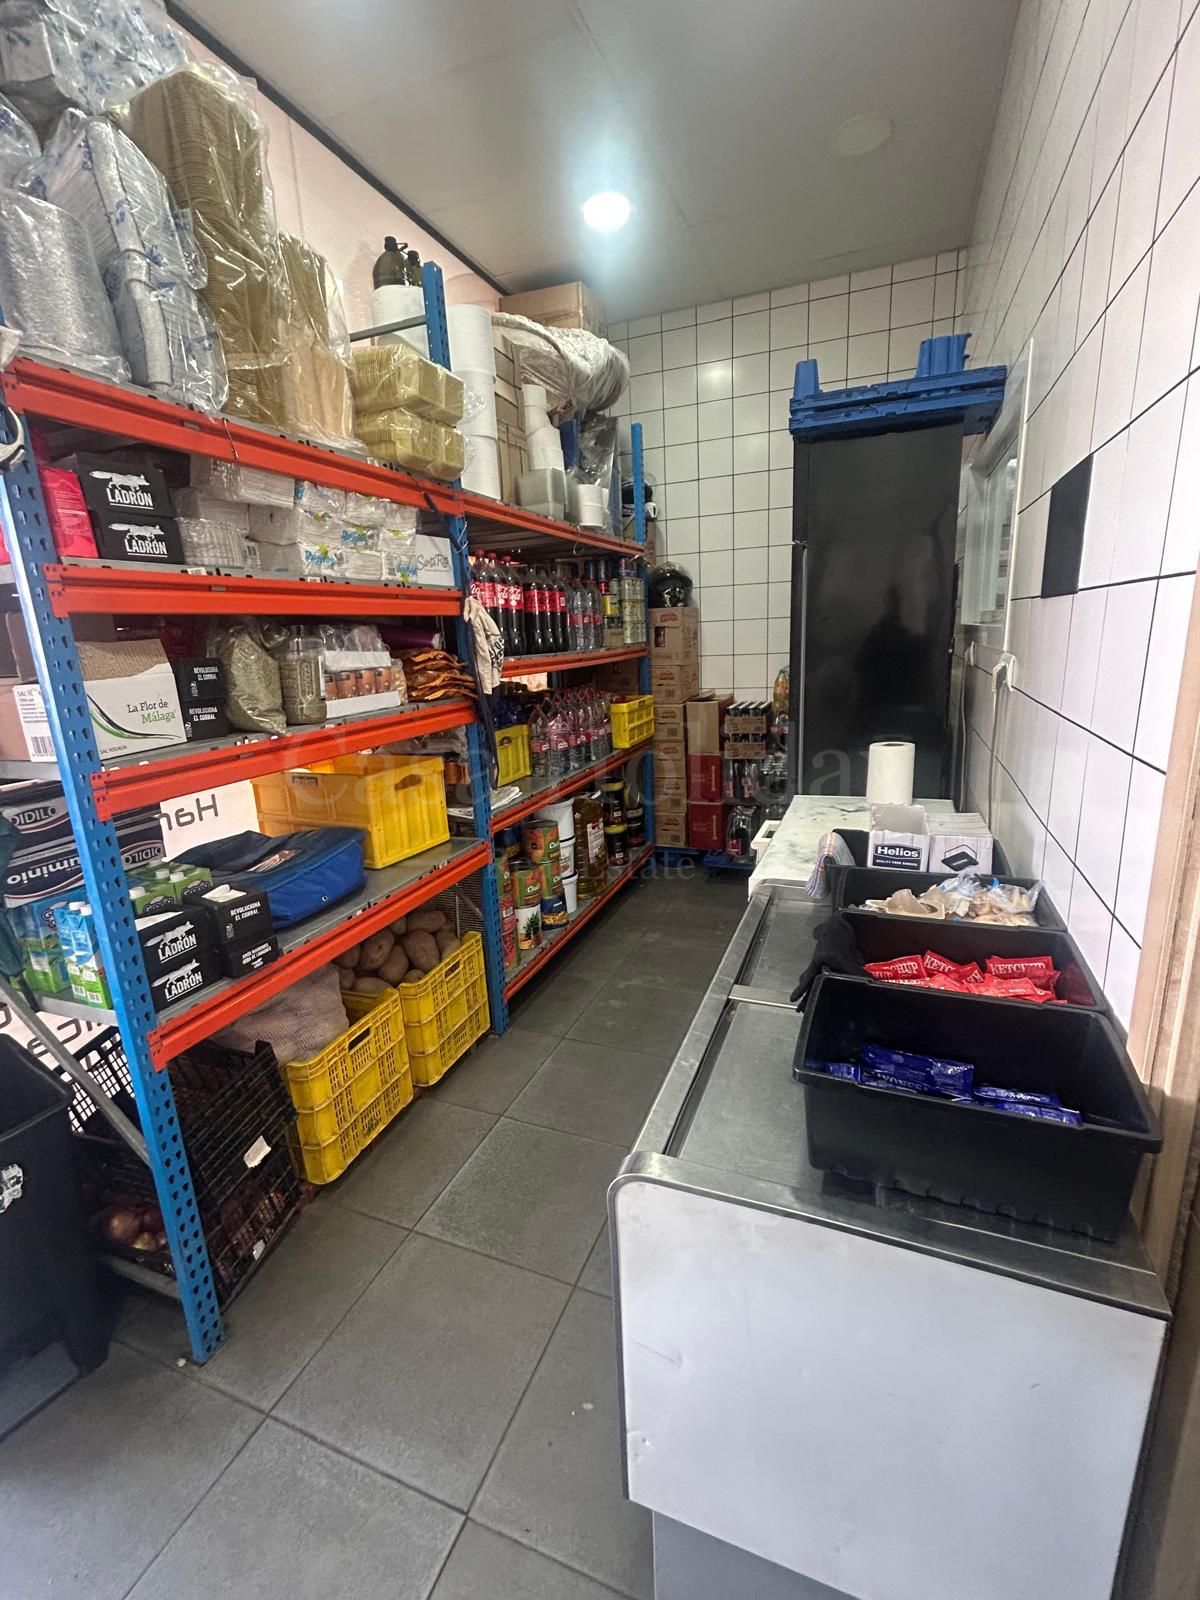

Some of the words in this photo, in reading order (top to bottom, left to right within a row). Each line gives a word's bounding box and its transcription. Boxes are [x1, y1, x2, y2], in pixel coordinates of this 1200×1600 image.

[106, 487, 154, 507] LADRÓN
[124, 538, 168, 555] LADRÓN
[127, 704, 139, 713] La
[139, 701, 157, 712] Flor
[158, 699, 168, 709] de
[142, 710, 176, 724] Málaga
[877, 846, 919, 858] Helios
[230, 901, 261, 917] REVOLUCIONA
[158, 932, 198, 960] LADRÓN
[164, 971, 203, 999] LADRÓN
